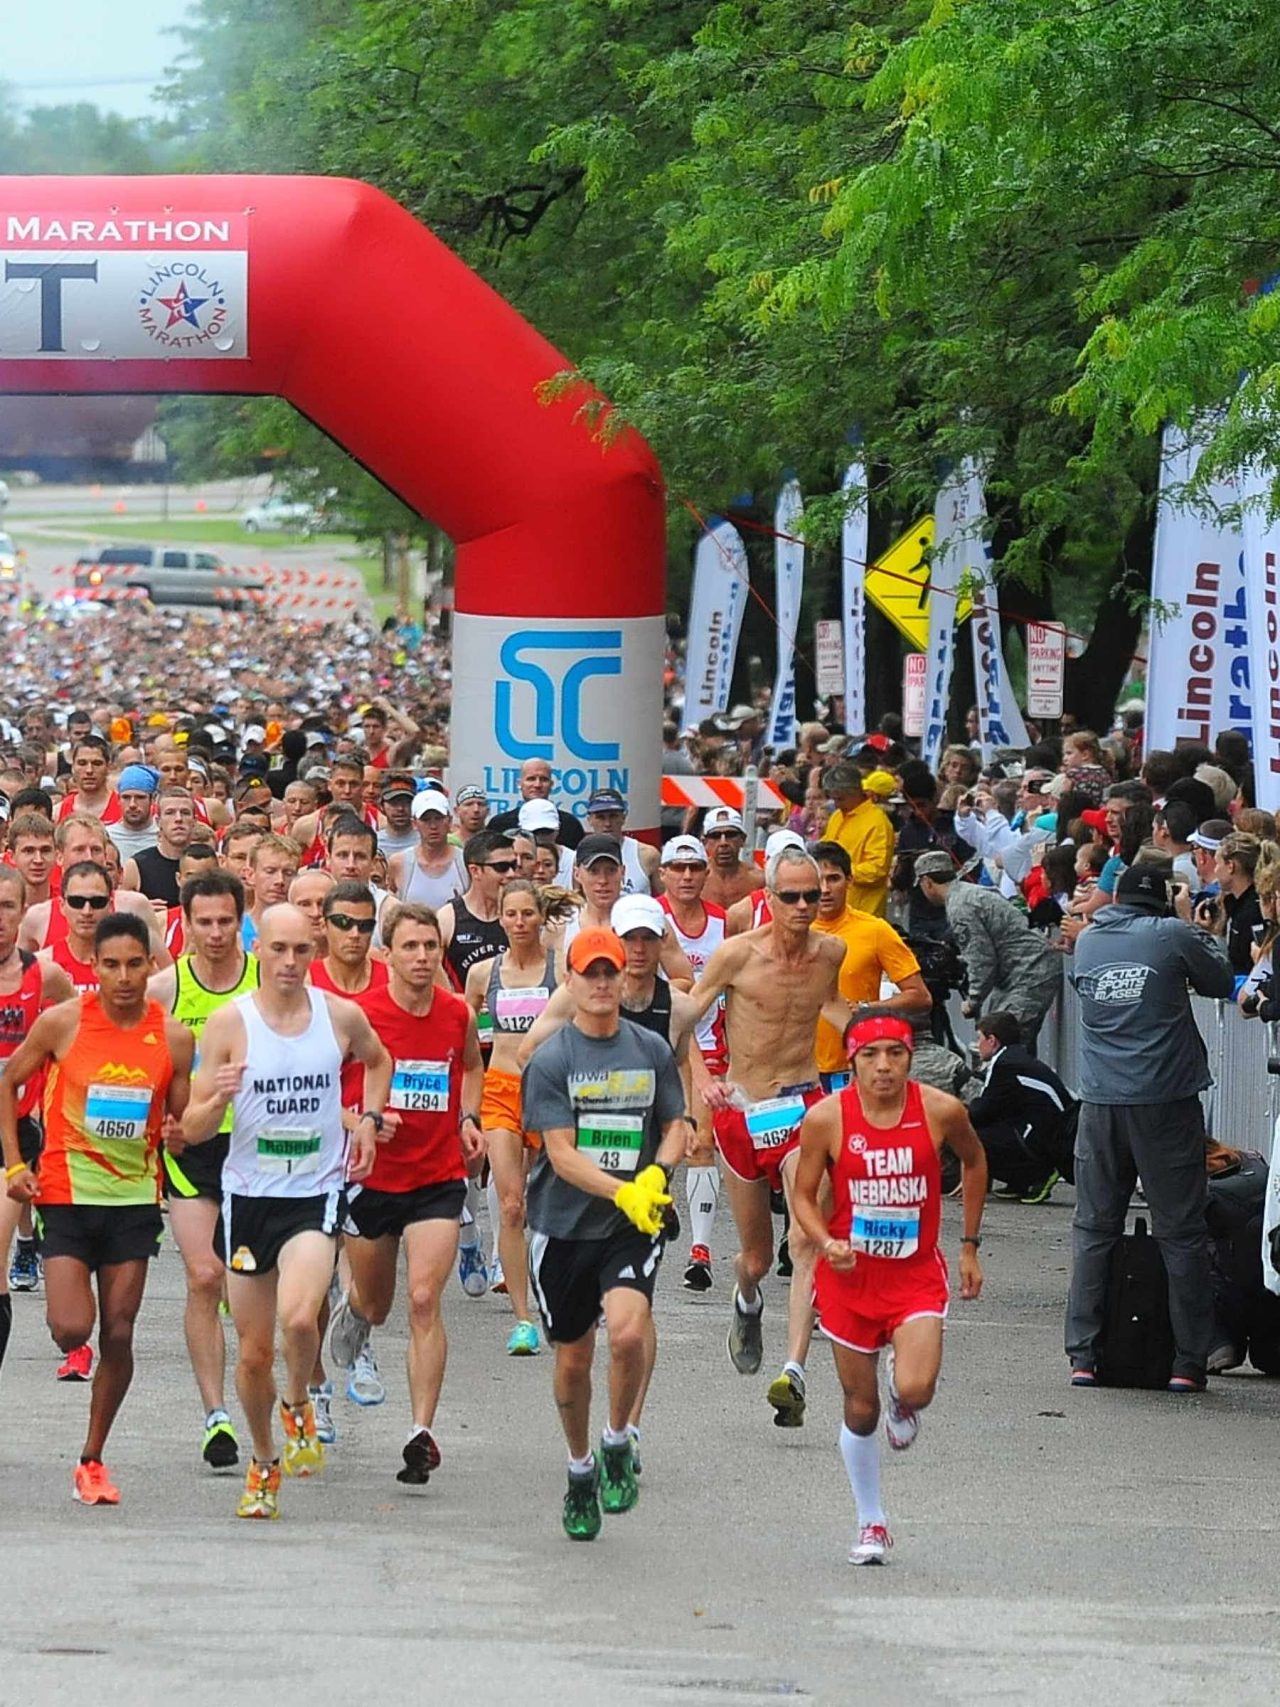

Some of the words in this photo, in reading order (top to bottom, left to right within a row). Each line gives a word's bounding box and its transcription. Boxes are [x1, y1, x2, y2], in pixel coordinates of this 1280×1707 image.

[6, 216, 230, 243] MARATHON
[140, 262, 224, 297] LINCOLN
[138, 307, 227, 349] MARATHON
[699, 610, 724, 706] Lincoln
[909, 655, 926, 673] NO
[1176, 562, 1221, 751] Lincoln
[461, 943, 495, 969] RIVER
[1098, 966, 1150, 981] ACTION
[1096, 977, 1147, 991] SPORTS
[1094, 988, 1143, 1001] IMAGES
[253, 1073, 331, 1095] NATIONAL
[403, 1073, 442, 1092] Bryce
[266, 1096, 321, 1116] GUARD
[403, 1093, 440, 1110] 1294
[95, 1119, 136, 1138] 4650
[591, 1130, 632, 1148] Brien
[286, 1159, 292, 1174] 1
[599, 1151, 621, 1169] 43
[862, 1147, 914, 1178] TEAM
[847, 1176, 928, 1207] NEBRASKA
[863, 1219, 908, 1241] Ricky
[862, 1239, 905, 1258] 1287
